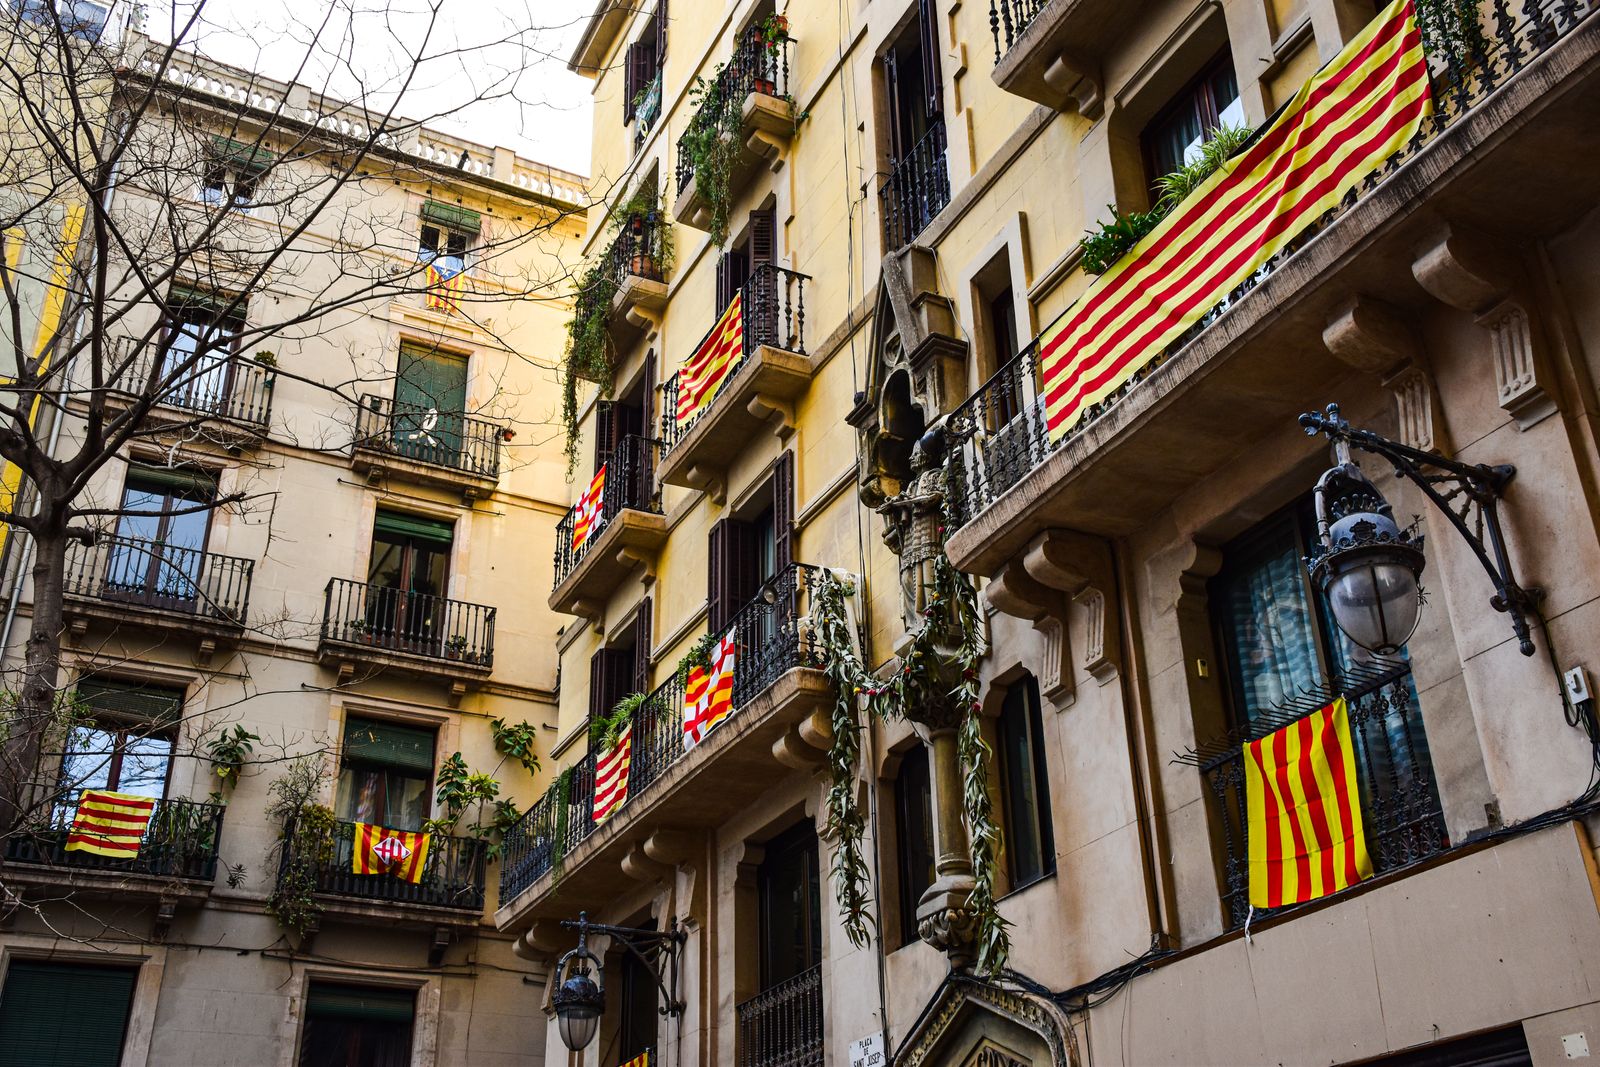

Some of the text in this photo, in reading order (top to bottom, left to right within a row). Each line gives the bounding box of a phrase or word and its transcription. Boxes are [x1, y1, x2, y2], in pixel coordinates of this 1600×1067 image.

[863, 1047, 869, 1056] DE
[853, 1052, 880, 1067] SANT JOSEP
